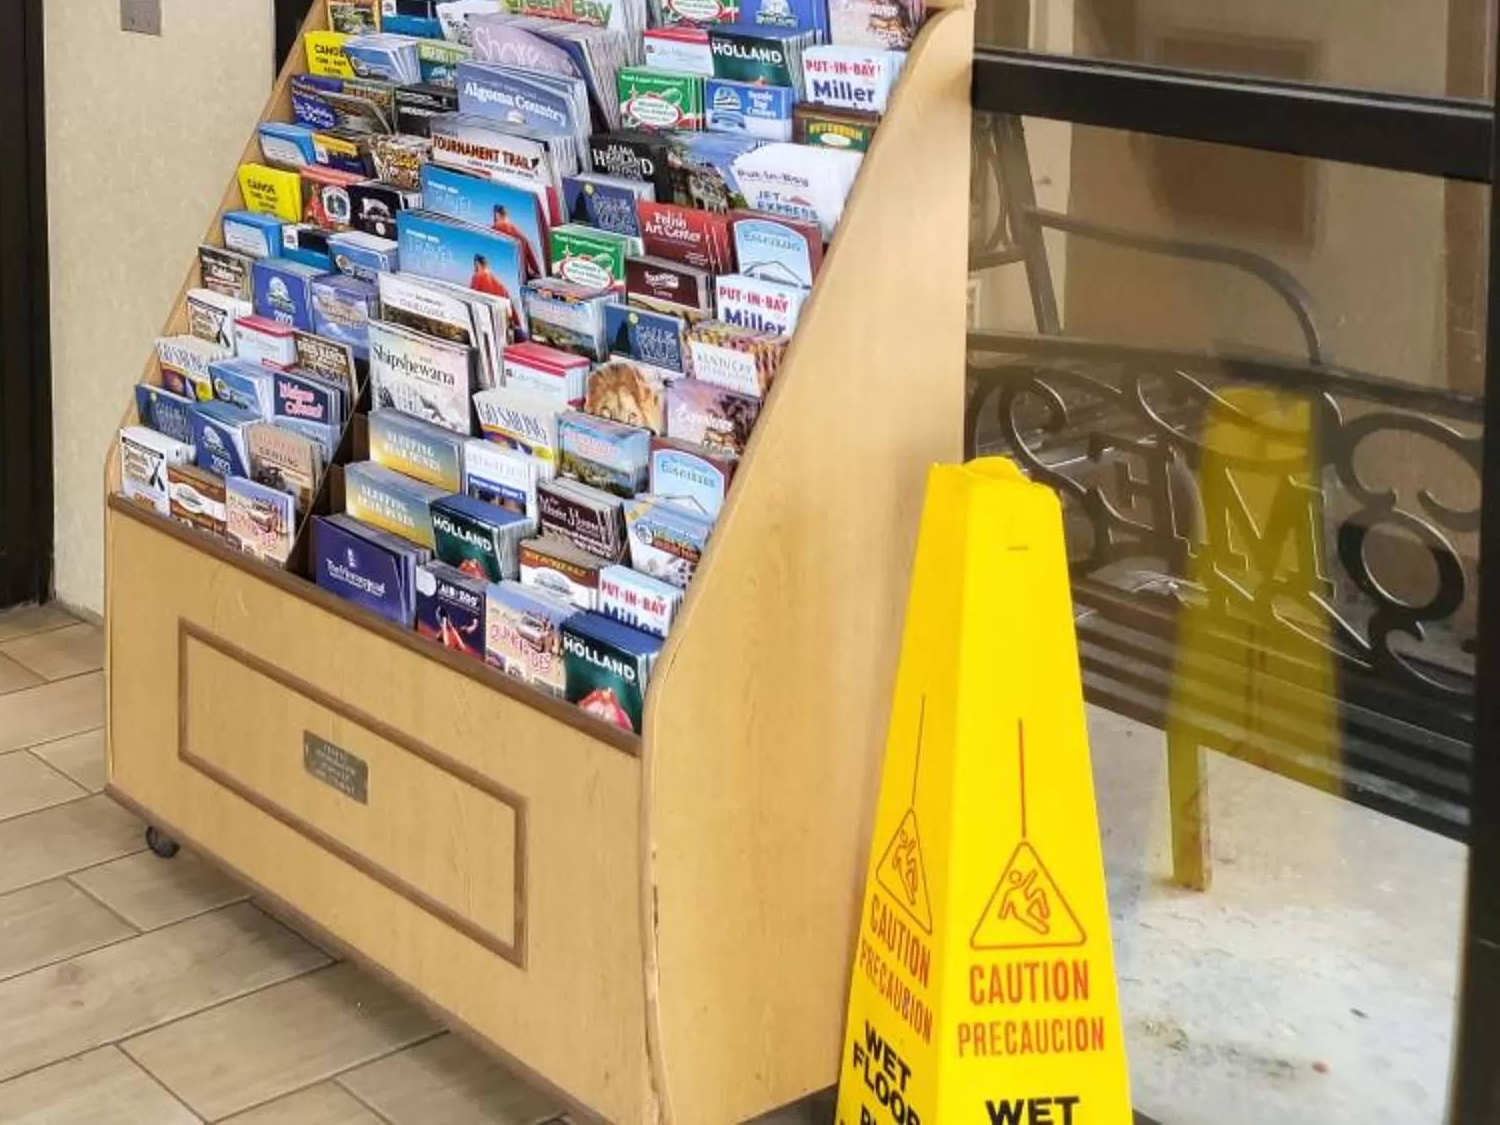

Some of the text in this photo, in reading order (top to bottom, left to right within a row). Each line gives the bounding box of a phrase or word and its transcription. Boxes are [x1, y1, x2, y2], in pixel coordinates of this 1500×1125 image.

[712, 41, 783, 64] HOLLAND
[464, 81, 568, 127] Algoma Country
[812, 78, 876, 104] Miller
[432, 134, 500, 162] TOURNAMENT
[502, 150, 533, 170] TRAIL
[756, 201, 819, 221] EXPRESS
[758, 190, 781, 202] JET
[645, 222, 662, 234] Art
[719, 286, 790, 313] PUT-IN-BAY
[724, 307, 788, 335] Miller
[433, 515, 493, 552] HOLLAND
[601, 580, 667, 616] PUT-IN-BAY
[563, 636, 635, 681] HOLLAND
[870, 893, 932, 989] CAUTION
[969, 959, 1090, 1006] CAUTION
[957, 1015, 1106, 1059] PRECAUCION
[864, 1018, 912, 1093] WET
[852, 1039, 921, 1125] FLOOR
[984, 1095, 1080, 1125] WET
